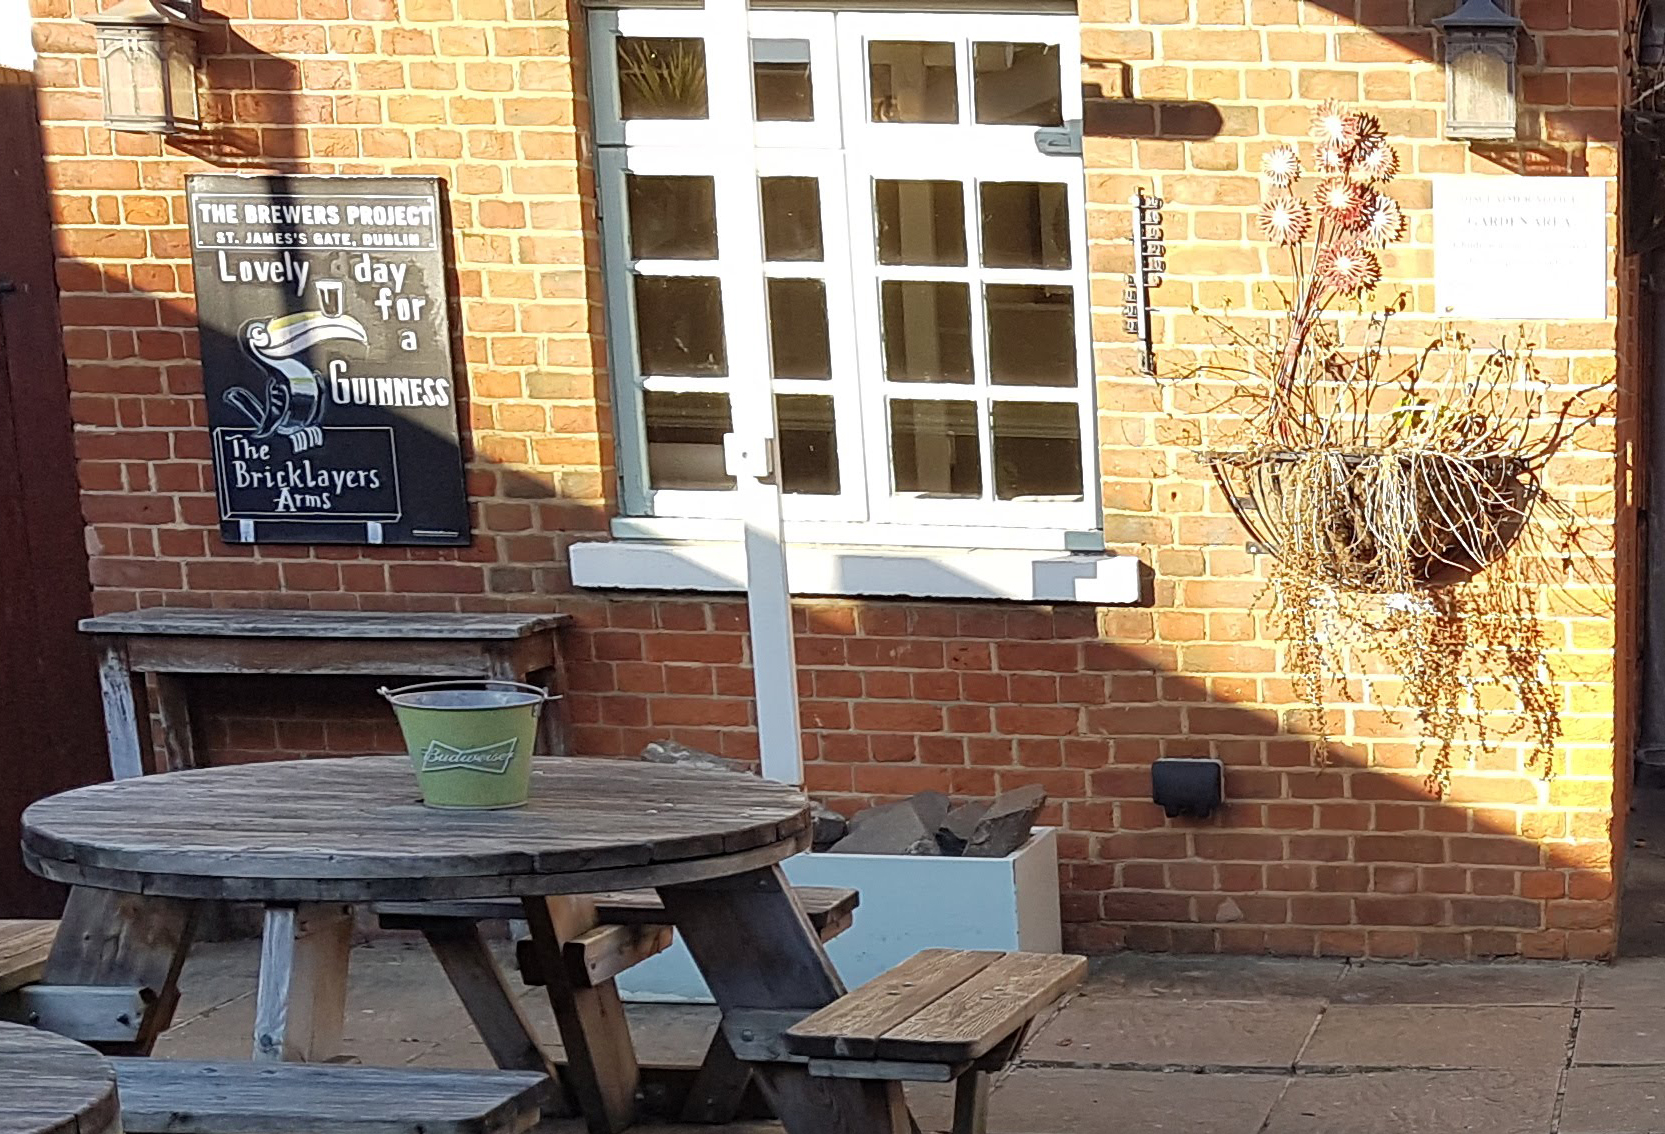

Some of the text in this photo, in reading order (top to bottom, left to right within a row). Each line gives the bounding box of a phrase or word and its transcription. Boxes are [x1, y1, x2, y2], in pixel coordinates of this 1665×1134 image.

[198, 204, 433, 226] THE BREWERS PROJECT
[216, 231, 239, 244] ST.
[246, 232, 308, 245] JAMES'S
[362, 233, 420, 247] DUBLIN
[218, 250, 407, 296] Lovely day
[375, 288, 426, 321] for
[401, 329, 418, 351] a
[329, 359, 450, 407] GUINNESS
[225, 434, 271, 460] The
[273, 487, 332, 513] Arms
